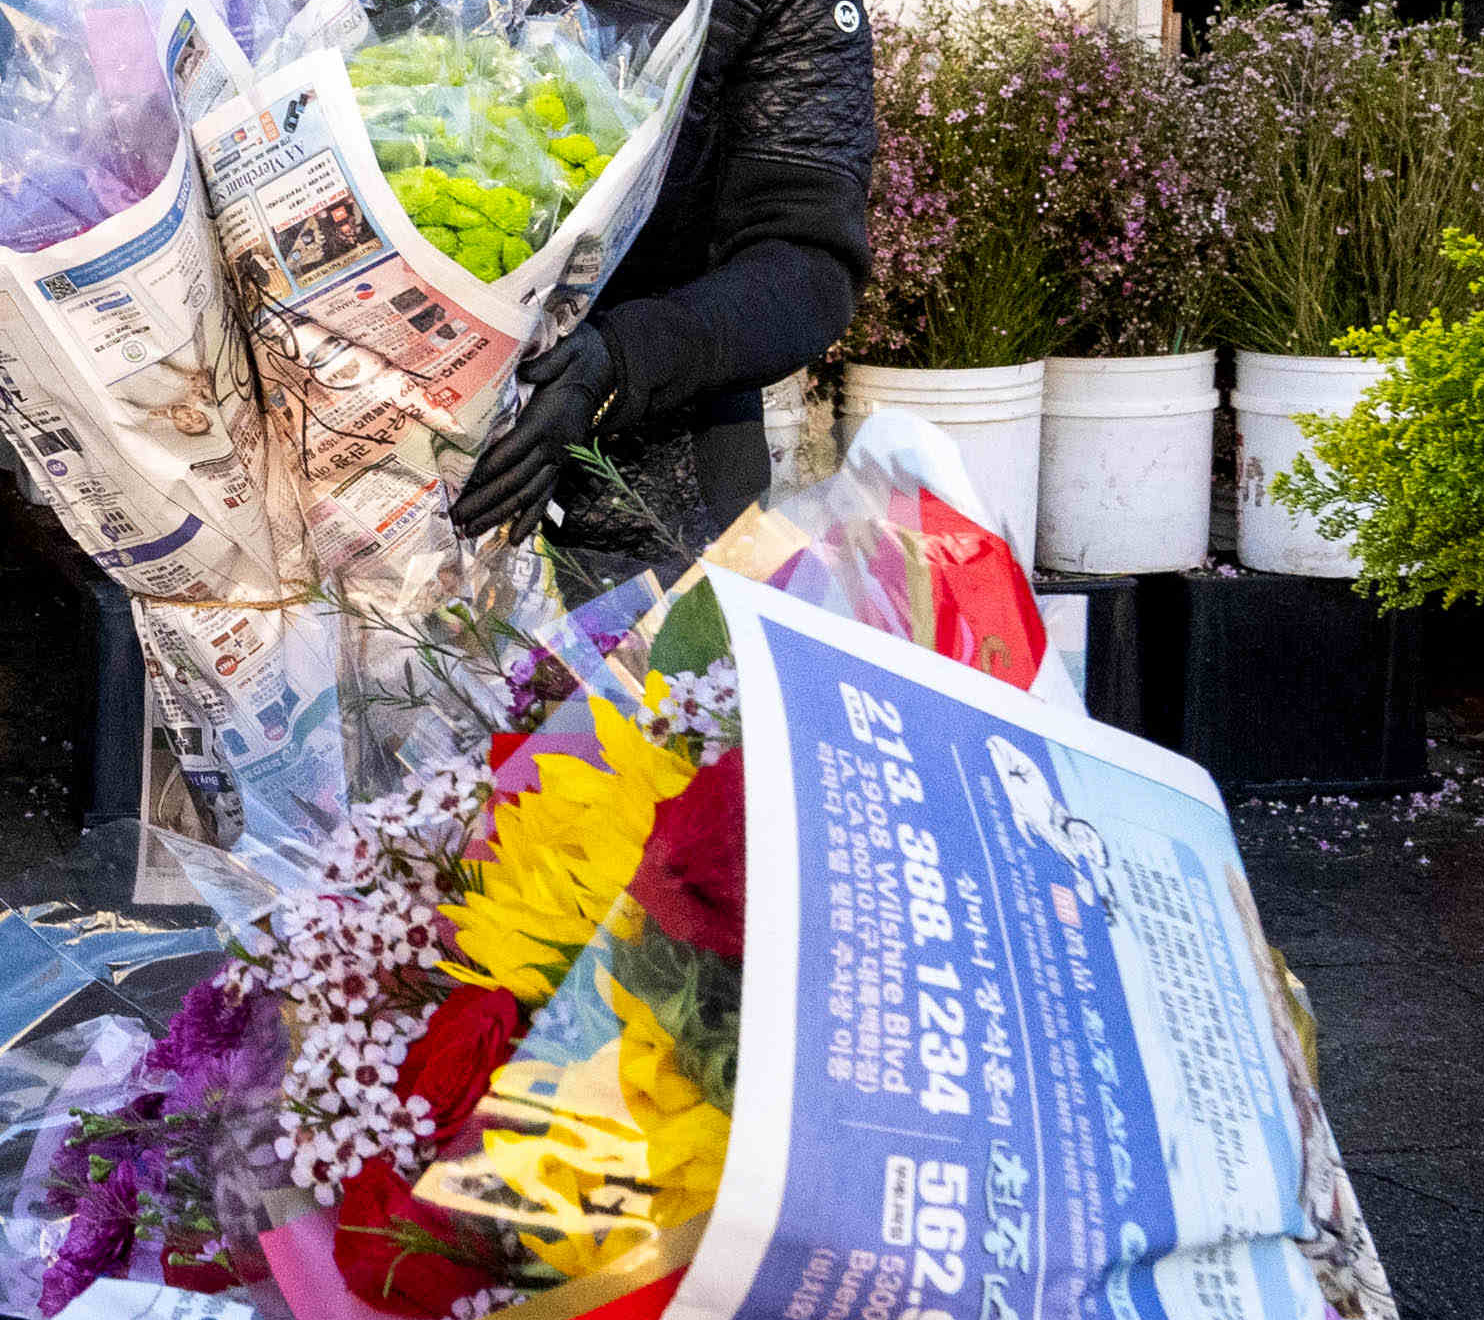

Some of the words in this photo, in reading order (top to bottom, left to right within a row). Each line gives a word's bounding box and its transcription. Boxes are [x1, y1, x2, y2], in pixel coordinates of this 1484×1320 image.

[223, 154, 286, 197] Merchant
[857, 690, 925, 805] 213.
[842, 788, 862, 826] CA
[853, 754, 893, 849] 3908
[850, 831, 872, 910] 90010
[894, 823, 953, 947] 388.
[874, 862, 907, 1005] Wilshire
[881, 1012, 911, 1094] Blvd
[914, 961, 971, 1116] 1234
